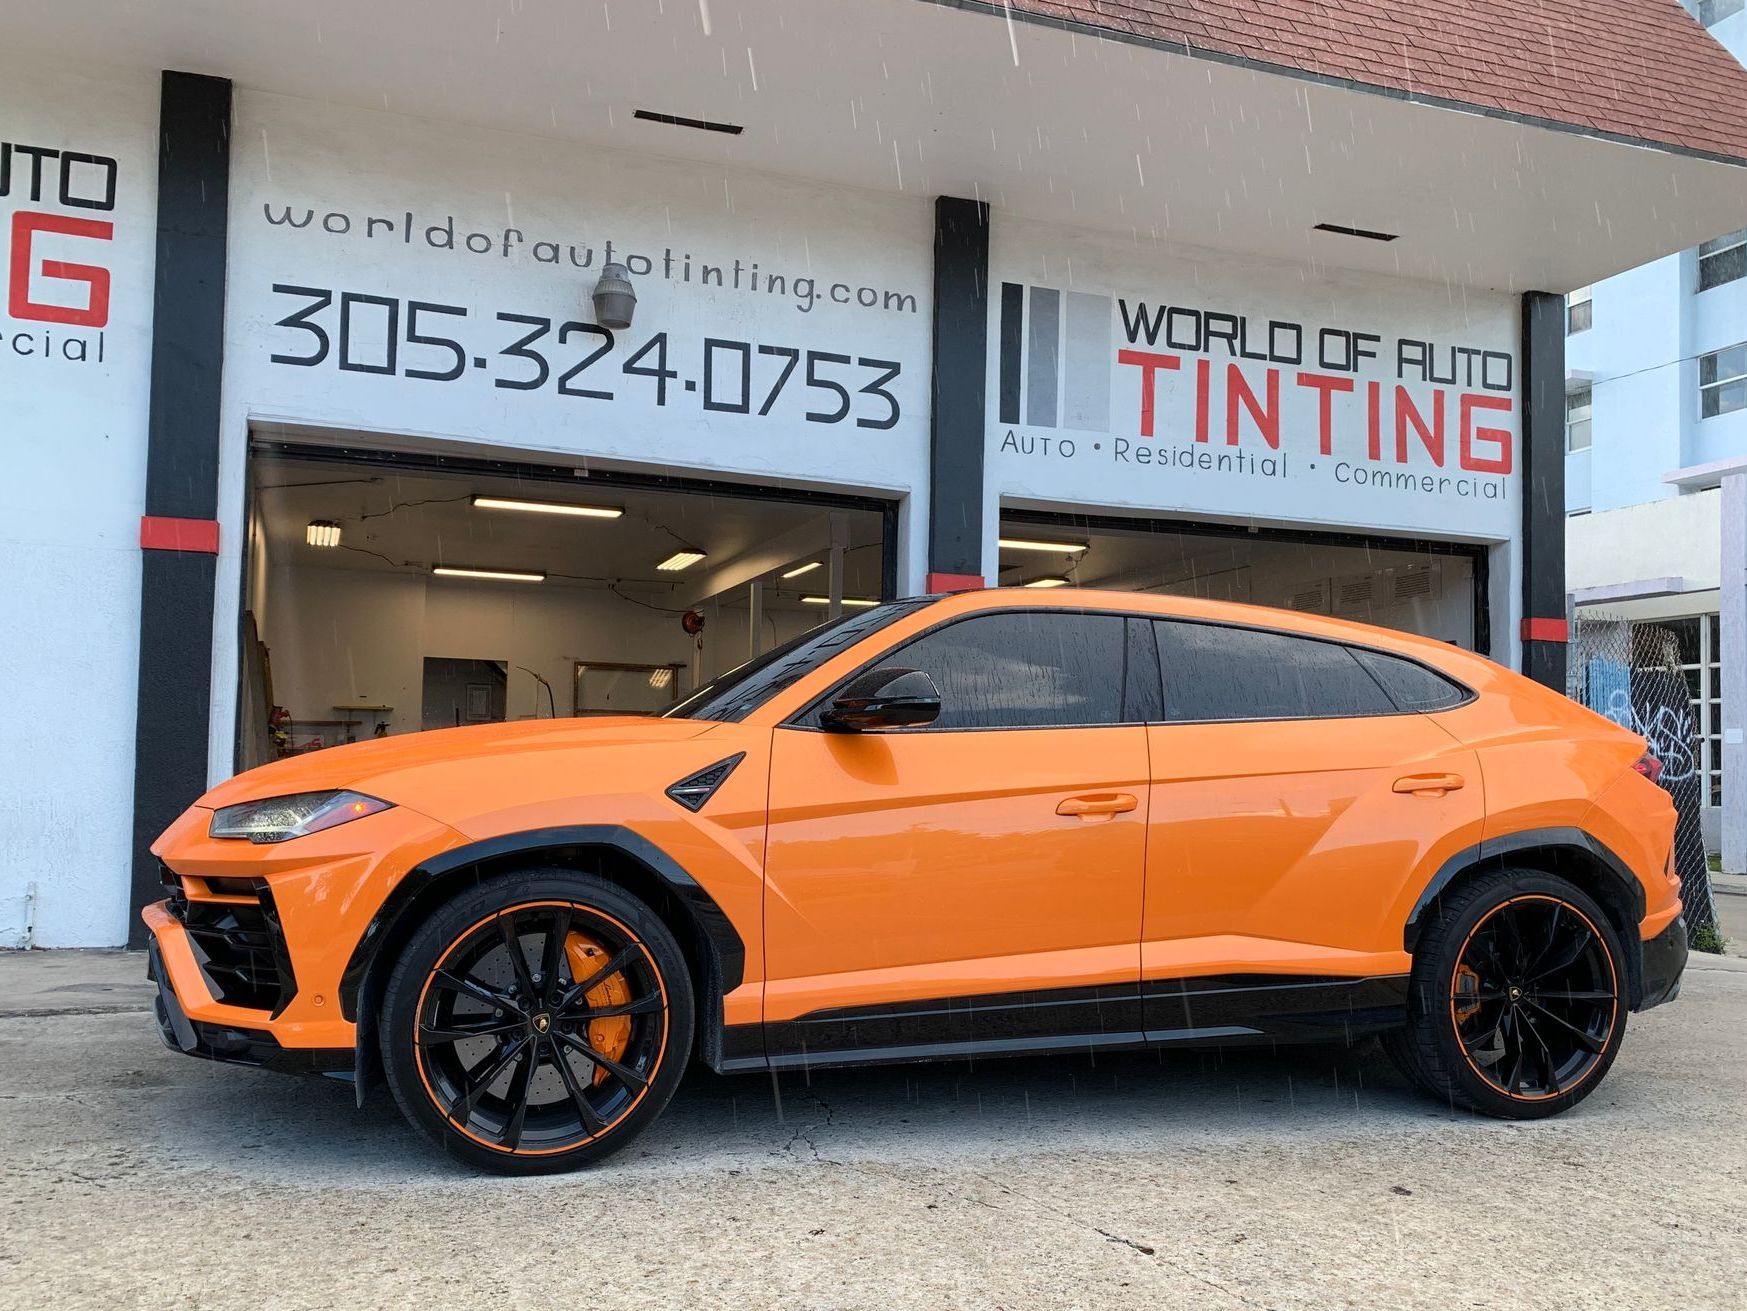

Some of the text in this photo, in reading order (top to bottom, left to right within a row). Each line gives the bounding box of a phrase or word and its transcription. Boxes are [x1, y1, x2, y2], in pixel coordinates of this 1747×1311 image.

[0, 141, 117, 211] TO
[263, 202, 917, 314] worldofautotinting.com
[0, 330, 104, 363] cial
[270, 283, 902, 430] 305.324.0753
[1117, 298, 1513, 392] WORLD OF AUTO
[1117, 348, 1513, 475] TINTING
[1113, 437, 1287, 478] Residential
[1334, 461, 1506, 500] Commercial
